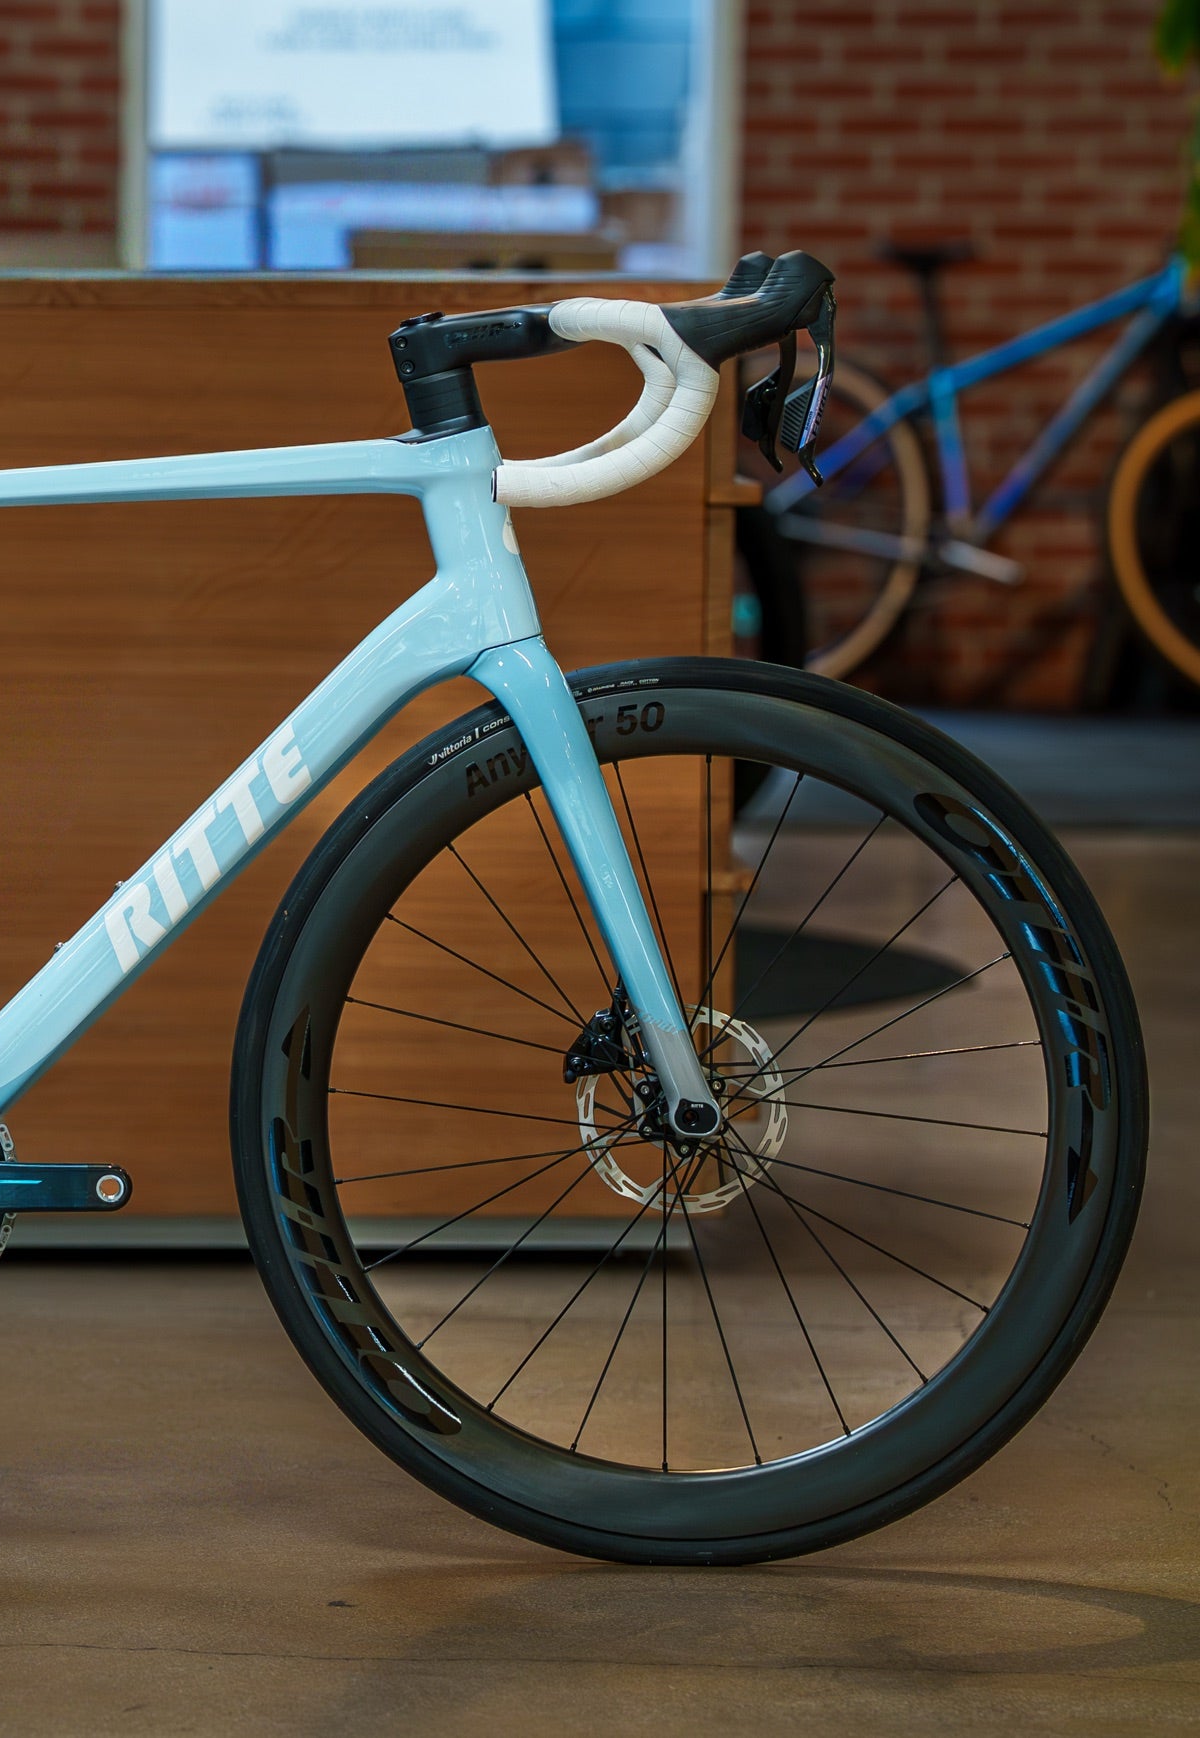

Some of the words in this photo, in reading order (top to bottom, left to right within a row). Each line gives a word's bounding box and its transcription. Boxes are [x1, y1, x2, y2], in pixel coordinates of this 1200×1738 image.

[438, 735, 473, 759] vittoria
[482, 715, 511, 733] cors
[616, 701, 666, 736] 50
[104, 721, 312, 974] RITTE
